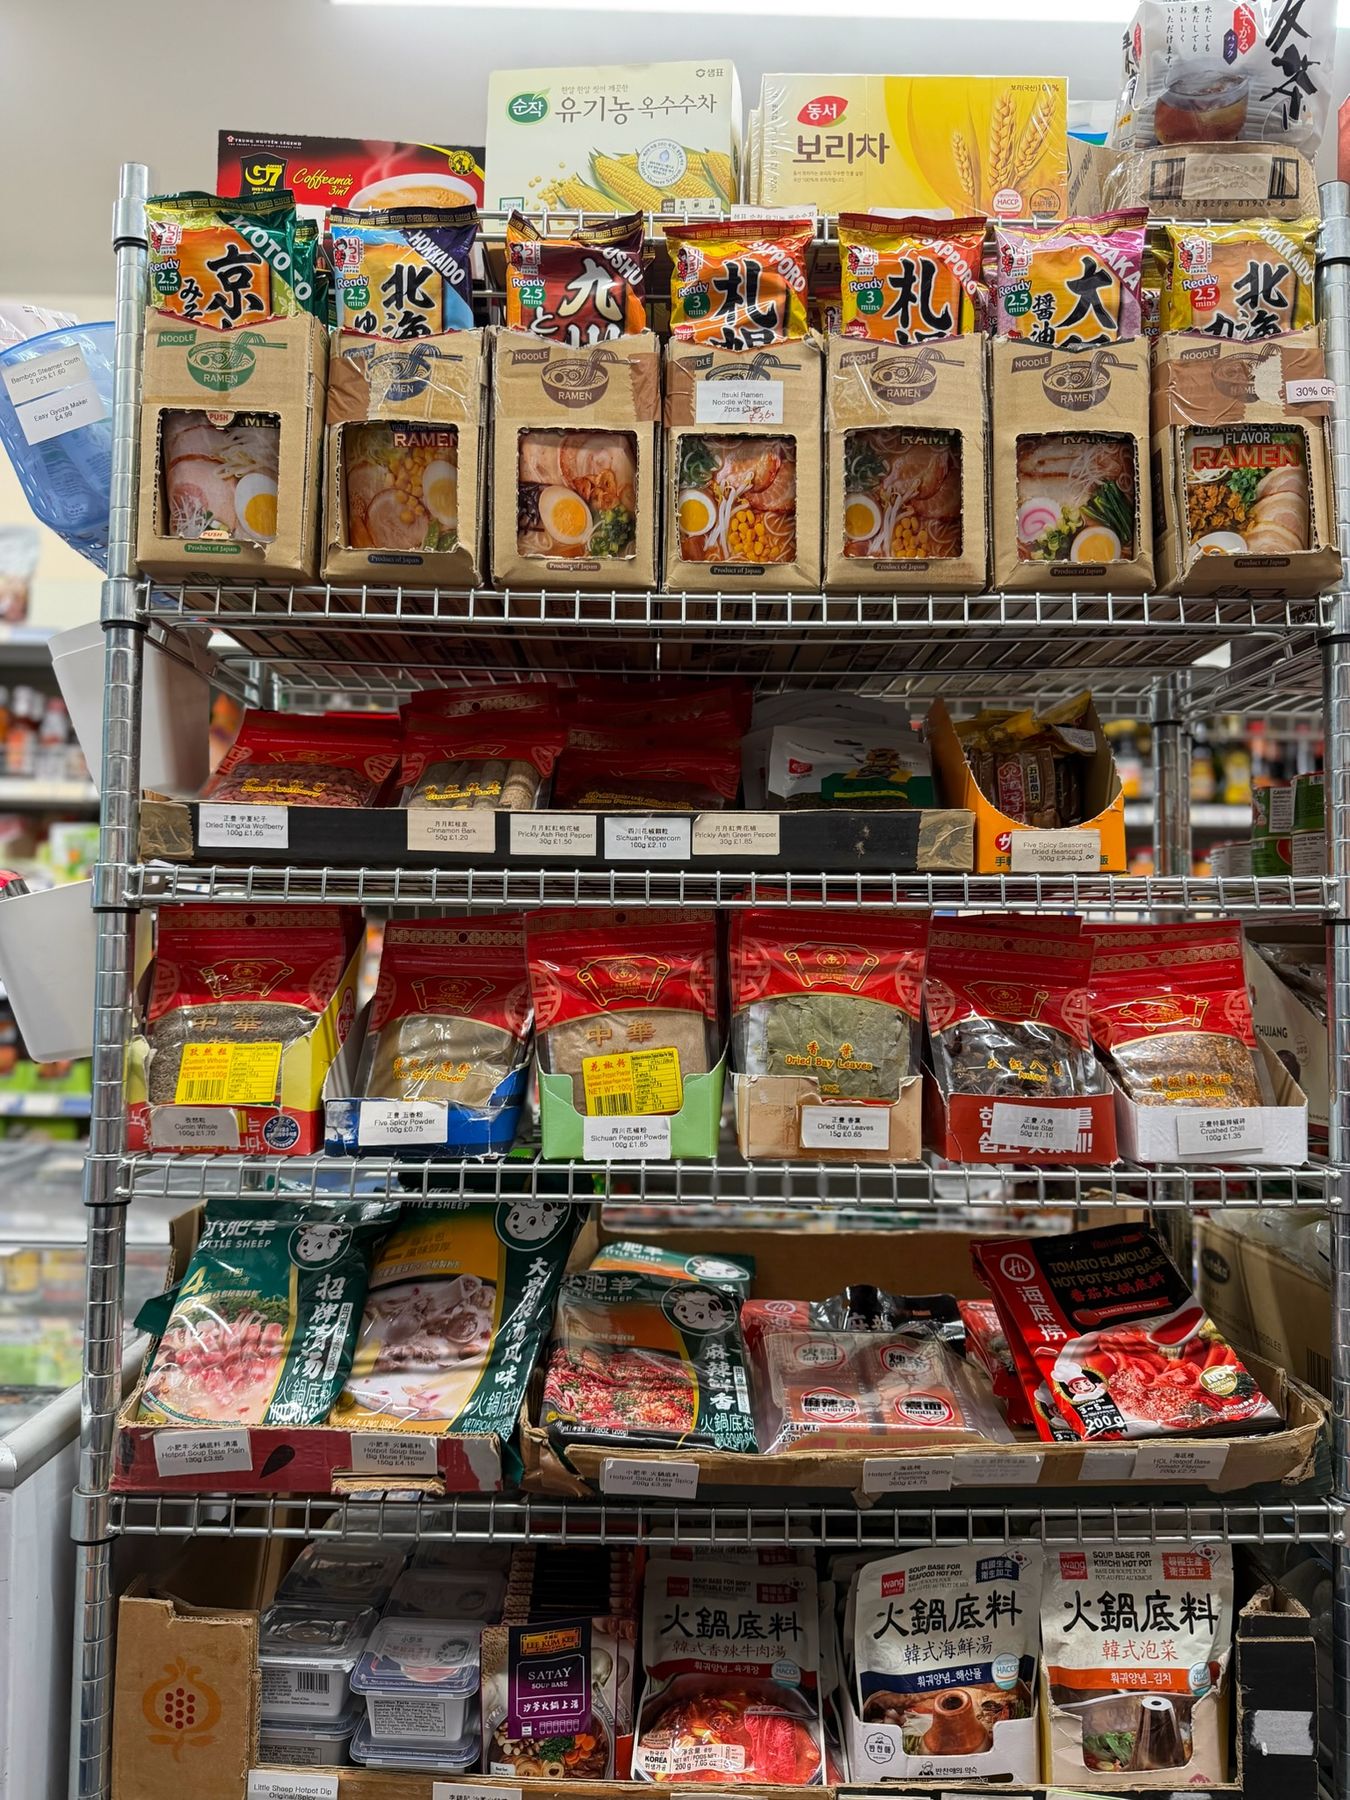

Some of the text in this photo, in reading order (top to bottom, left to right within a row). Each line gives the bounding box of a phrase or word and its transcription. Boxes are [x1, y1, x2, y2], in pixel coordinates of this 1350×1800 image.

[1203, 5, 1213, 53] 水だしでも
[1226, 34, 1236, 59] パック
[706, 68, 724, 77] 샘표
[511, 98, 544, 118] 순작
[555, 93, 717, 125] 유기농 옥수수차
[806, 103, 838, 120] 동서
[792, 132, 890, 164] 보리차
[245, 165, 283, 187] G7
[328, 185, 350, 196] 3in1
[997, 198, 1019, 206] HACCP
[229, 214, 291, 271] KYOTO
[408, 230, 466, 285] HOKKAIDO
[1259, 226, 1315, 285] HOKKAIDO
[150, 259, 180, 273] Ready
[748, 240, 806, 292] SAPPORO
[921, 237, 978, 295] SAPPORO
[1080, 235, 1142, 291] OSAKA
[158, 272, 178, 284] 2.5
[337, 275, 369, 289] Ready
[512, 278, 545, 287] Ready
[1182, 274, 1219, 291] Ready
[159, 284, 179, 292] mins
[678, 281, 709, 298] Ready
[850, 278, 884, 292] Ready
[999, 279, 1032, 297] Ready
[346, 288, 366, 300] 2.5
[522, 288, 543, 299] 2.5
[866, 291, 875, 304] 3
[1194, 287, 1216, 300] 2.5
[347, 299, 367, 307] mins
[692, 296, 702, 309] 3
[1007, 293, 1029, 307] 2.5
[1195, 300, 1216, 308] mins
[1008, 306, 1029, 314] mins
[160, 334, 195, 343] NOODLE
[515, 350, 548, 361] NOODLE
[842, 351, 876, 365] NOODLE
[1182, 349, 1219, 361] NOODLE
[1015, 356, 1050, 368] NOODLE
[203, 373, 239, 384] RAMEN
[558, 391, 593, 400] RAMEN
[741, 391, 764, 399] Ramen
[886, 388, 921, 398] RAMEN
[1295, 386, 1335, 396] 30% OFF
[1060, 393, 1096, 403] RAMEN
[724, 406, 740, 414] 2pcs
[209, 413, 229, 421] PUSH
[393, 433, 459, 447] RAMEN
[1225, 432, 1271, 444] FLAVOR
[1193, 446, 1299, 468] RAMEN
[225, 822, 251, 831] NingXia
[252, 822, 284, 831] Wolfberry
[226, 829, 264, 837] 100g £1.65
[517, 831, 539, 839] Prickly
[643, 835, 681, 843] Peppercorn
[695, 831, 717, 839] Prickly
[753, 831, 777, 839] Pepper
[1038, 842, 1057, 850] Spicy
[586, 1021, 656, 1047] 中華
[786, 1055, 873, 1071] Dried Bay Leaves
[1165, 1088, 1226, 1099] Crushed Chilli
[374, 1118, 435, 1127] Five Spicy Powder
[837, 1123, 850, 1131] Bay
[851, 1123, 874, 1131] Leaves
[1020, 1123, 1040, 1131] Anise
[386, 1126, 403, 1134] 100g
[1019, 1129, 1033, 1137] 50g
[1200, 1125, 1246, 1135] Crushed Chilli
[619, 1134, 642, 1142] Pepper
[643, 1133, 669, 1141] Powder
[1205, 1132, 1242, 1142] 100g £1.35
[611, 1141, 628, 1149] 100g
[1049, 1247, 1154, 1275] TOMATO FLAVOUR
[1051, 1254, 1168, 1288] HOT POT SOUP BASE
[161, 1447, 245, 1460] Hotpot Soup Base Plain
[1092, 1551, 1151, 1560] SOUP BASE FOR
[908, 1563, 961, 1574] SOUP BASE FOR
[1093, 1559, 1153, 1568] KIMCHI HOT POT
[908, 1569, 963, 1582] SEAFOOD HOT POT
[873, 1590, 1023, 1640] 火鍋底料
[1062, 1589, 1219, 1635] 火鍋底料
[660, 1604, 804, 1642] 火鍋底料
[903, 1635, 993, 1666] 韓式海鮮湯
[1101, 1639, 1179, 1662] 韓式泡菜
[528, 1667, 572, 1681] SATAY
[531, 1681, 569, 1690] SOUP BASE
[644, 1755, 668, 1764] KOREA
[253, 1783, 270, 1791] Little
[295, 1786, 318, 1794] Hotpot
[320, 1787, 332, 1796] Dip
